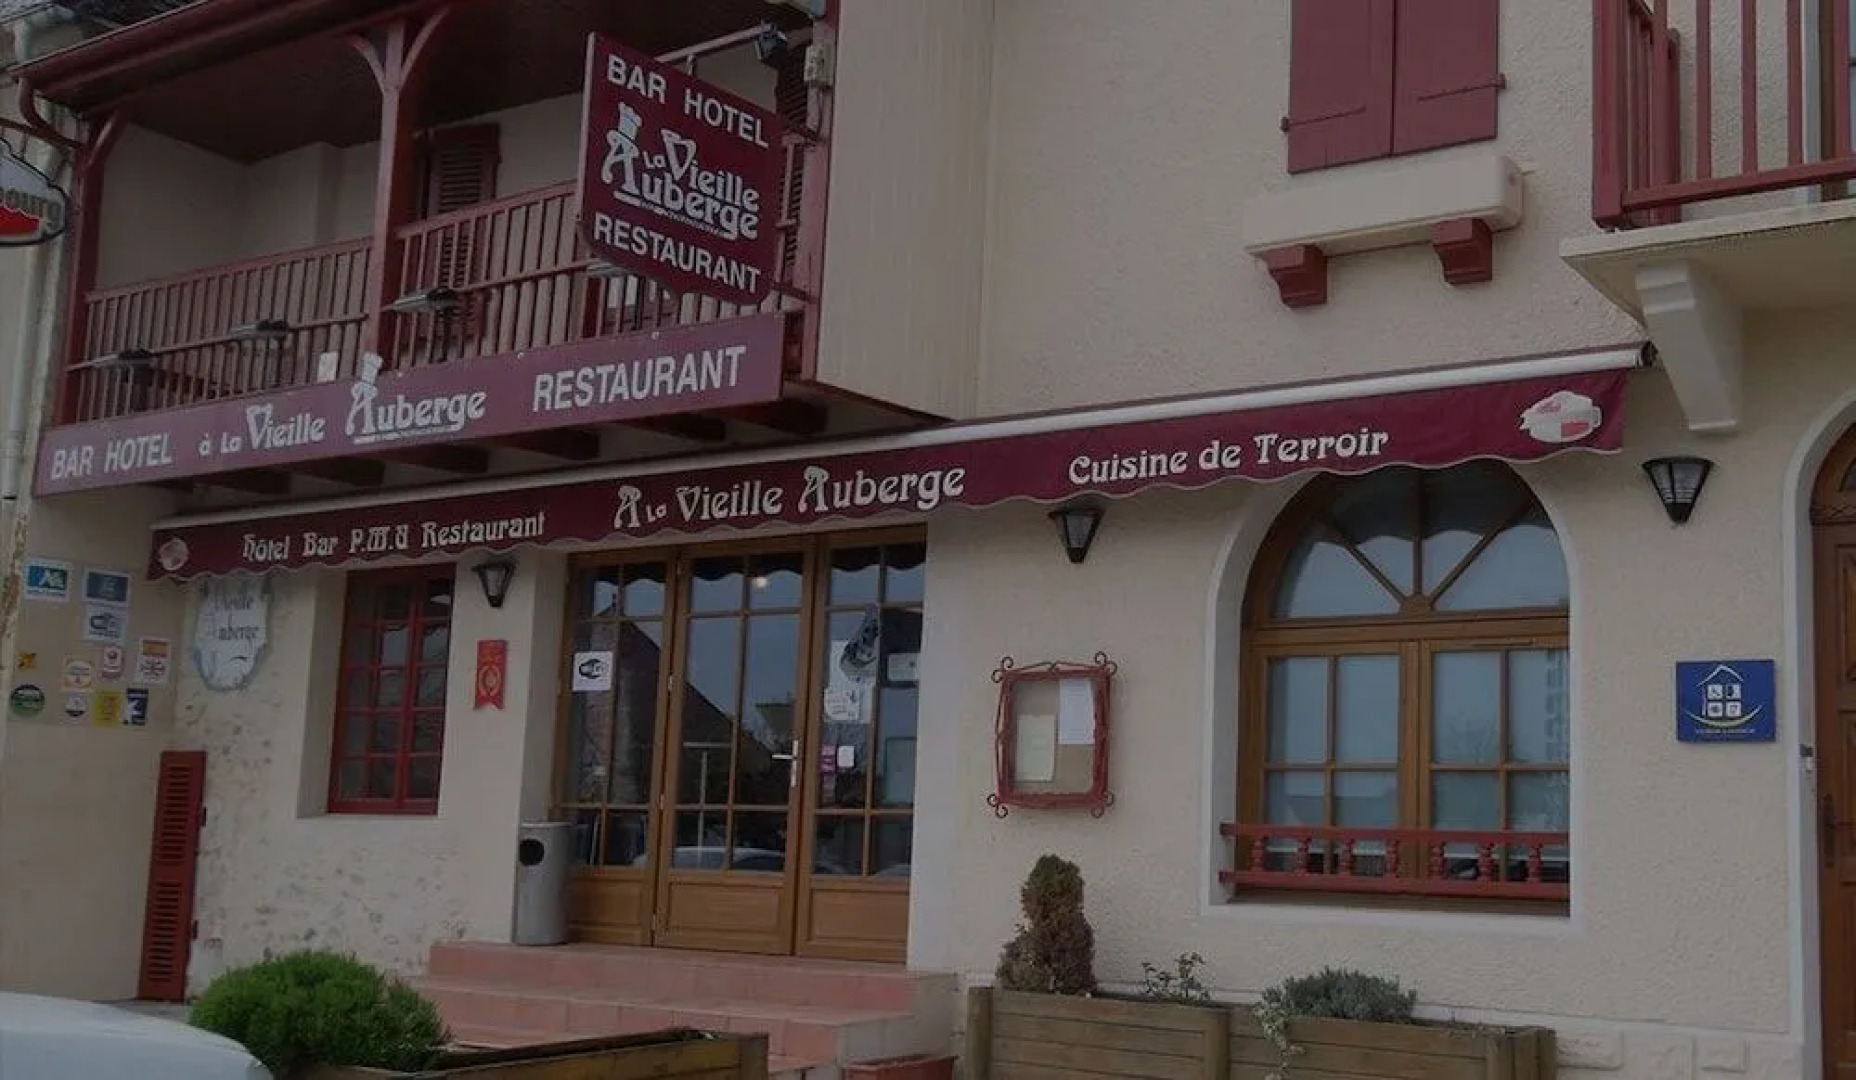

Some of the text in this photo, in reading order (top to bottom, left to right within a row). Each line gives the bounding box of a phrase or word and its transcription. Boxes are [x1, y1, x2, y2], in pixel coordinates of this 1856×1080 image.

[608, 54, 769, 149] BAR HOTEL
[602, 130, 760, 240] Auberge
[660, 128, 760, 212] Vieille
[593, 212, 760, 293] RESTAURANT
[51, 446, 94, 480] BAR
[104, 433, 172, 473] HOTEL
[247, 404, 326, 449] Vieille
[346, 381, 488, 435] Auberge
[532, 346, 747, 412] RESTAURANT
[302, 532, 339, 557] Bar
[421, 511, 545, 548] Restaurant
[614, 486, 642, 528] A
[676, 480, 783, 522] Vieille
[798, 465, 965, 510] Auberge
[1069, 450, 1188, 485] Cuisine
[1199, 440, 1242, 471] de
[1254, 427, 1389, 464] Terroir
